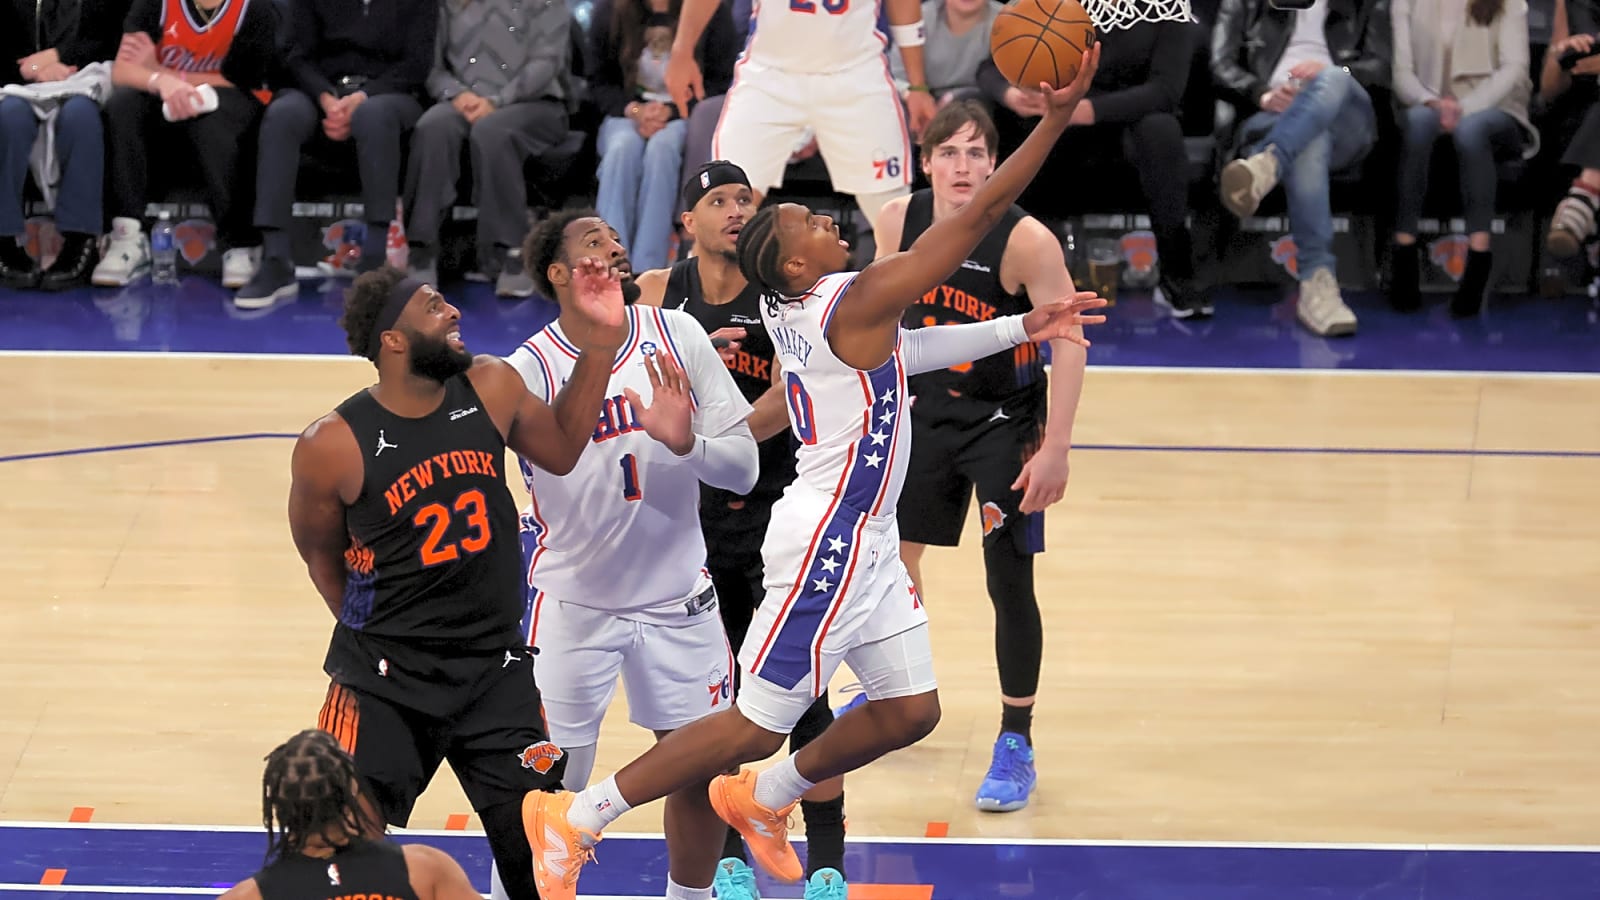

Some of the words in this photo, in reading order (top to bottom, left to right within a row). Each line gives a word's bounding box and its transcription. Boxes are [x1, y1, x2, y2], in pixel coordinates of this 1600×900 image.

[873, 156, 900, 179] 76
[940, 285, 997, 322] YORK
[722, 350, 769, 380] ORK
[772, 327, 813, 367] MAXEY
[786, 371, 817, 446] 0
[384, 459, 434, 517] NEW
[432, 449, 497, 478] YORK
[619, 452, 642, 501] 1
[413, 489, 492, 567] 23
[907, 586, 920, 610] 7
[707, 673, 730, 707] 76
